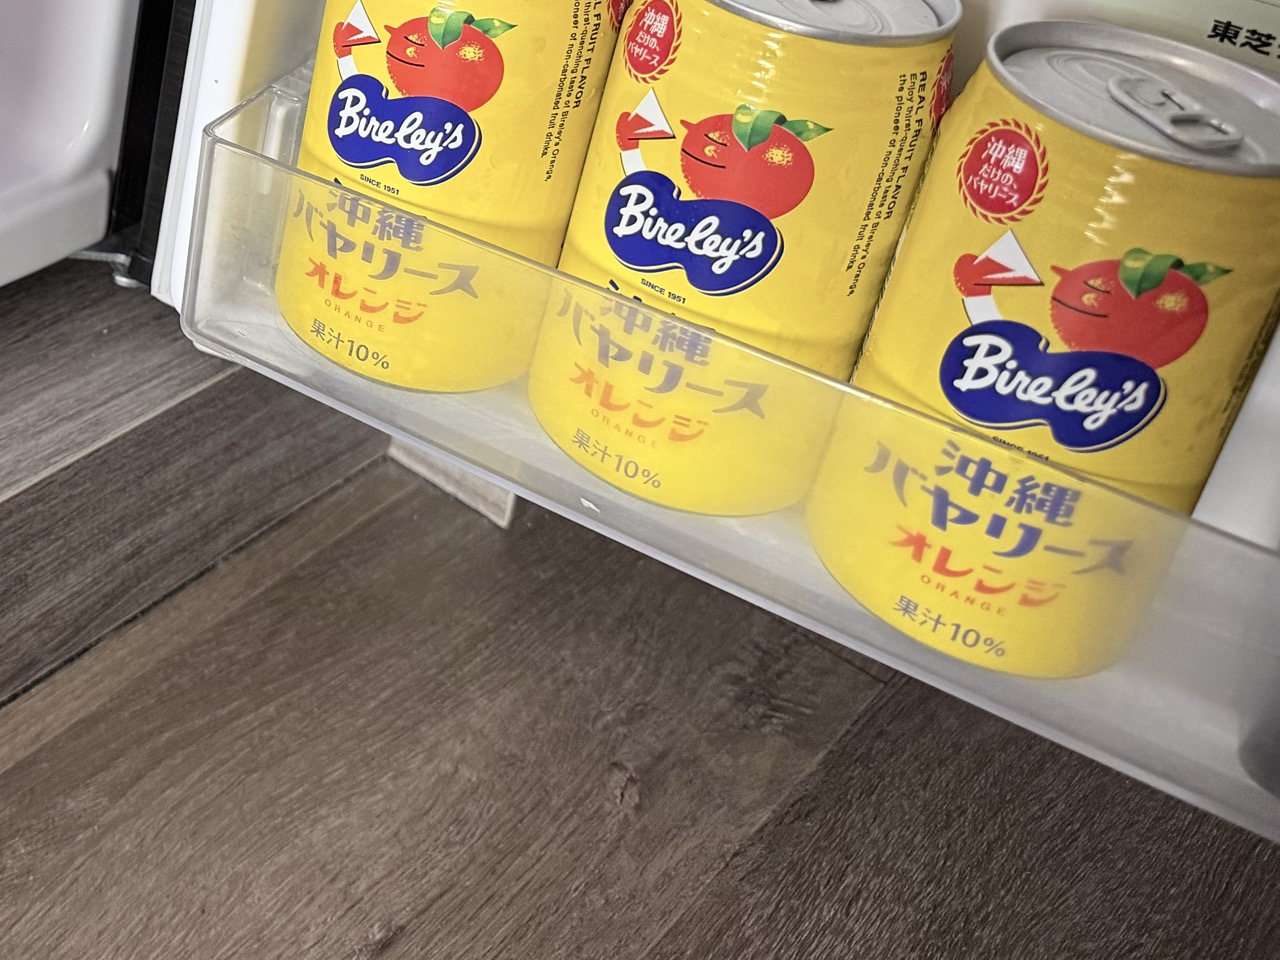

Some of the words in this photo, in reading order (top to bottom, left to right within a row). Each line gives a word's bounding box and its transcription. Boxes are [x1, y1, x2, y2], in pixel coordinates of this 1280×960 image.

[586, 12, 602, 53] FRUIT
[639, 6, 670, 38] 沖縄
[1207, 19, 1280, 58] 東芝
[552, 43, 574, 110] non-carbonated
[628, 41, 660, 67] バヤリース
[572, 57, 592, 109] FLAVOR
[897, 74, 907, 93] the
[906, 73, 917, 103] Enjoy
[915, 70, 928, 115] REAL
[333, 87, 466, 166] Bireley's
[548, 112, 558, 129] fruit
[892, 95, 904, 135] pioneer
[904, 118, 923, 162] FRUIT
[981, 136, 1028, 174] 沖縄
[359, 173, 382, 190] SINCE
[382, 183, 400, 196] 1951
[883, 165, 908, 220] FLAVOR
[966, 175, 1019, 207] バヤリース
[325, 178, 428, 252] 沖縄
[612, 183, 766, 275] Bireley's
[293, 188, 481, 300] バヤリース
[304, 257, 429, 326] オレンジ
[324, 297, 386, 333] ORANGE
[640, 277, 666, 298] SINCE
[666, 290, 687, 305] 1951
[310, 317, 391, 370] 果汁10%
[598, 279, 716, 367] 沖縄
[556, 287, 770, 420] バヤリース
[568, 361, 709, 443] オレンジ
[952, 334, 1150, 430] Bireley's
[591, 407, 659, 449] ORANGE
[571, 426, 662, 490] 果汁10%
[934, 439, 1084, 528] 沖縄
[863, 440, 1135, 576] バヤリース
[888, 524, 1067, 608] オレンジ
[920, 573, 1007, 617] ORANGE
[894, 594, 1007, 659] 果汁10%
